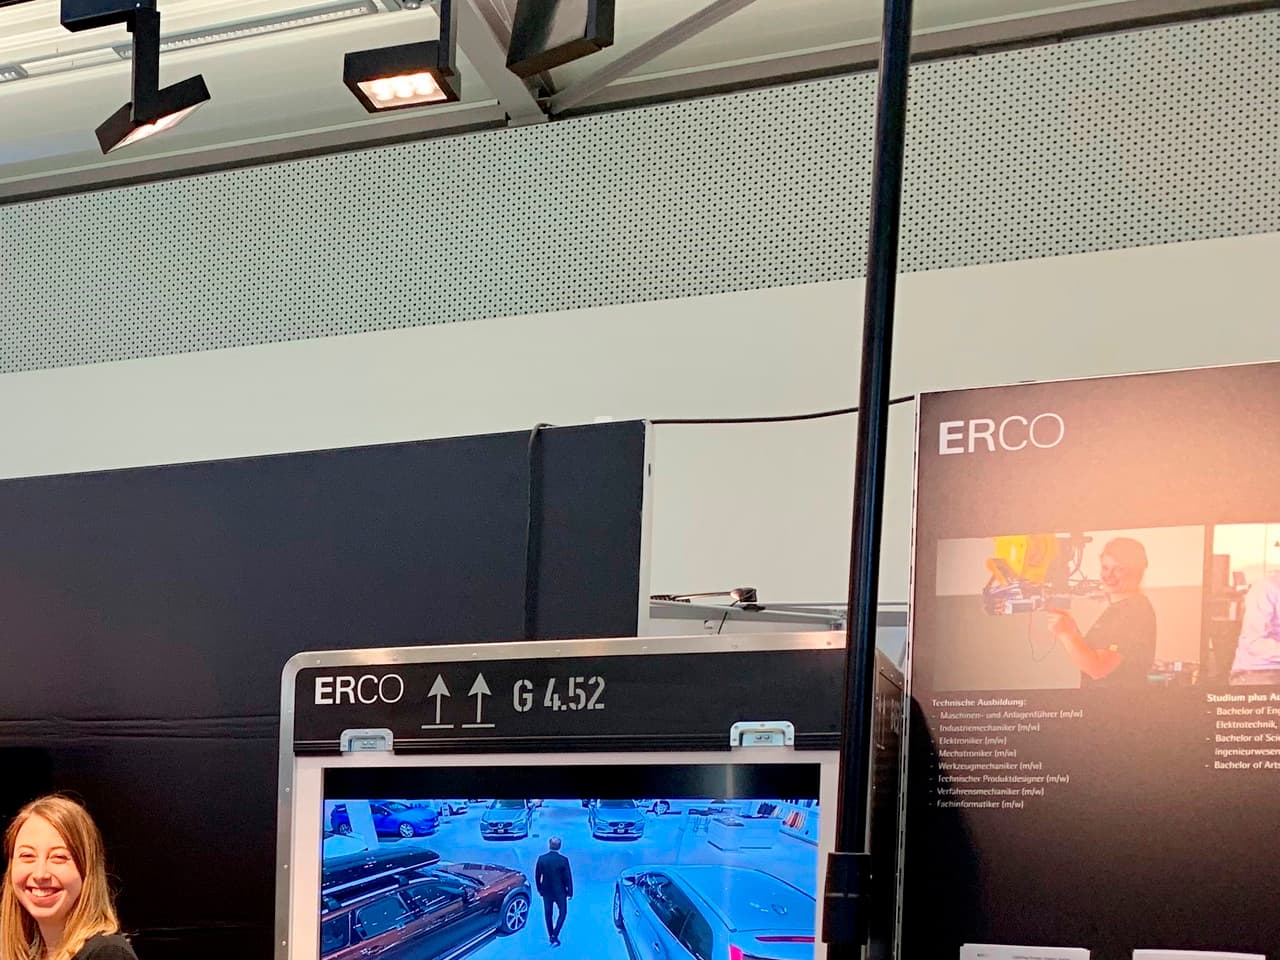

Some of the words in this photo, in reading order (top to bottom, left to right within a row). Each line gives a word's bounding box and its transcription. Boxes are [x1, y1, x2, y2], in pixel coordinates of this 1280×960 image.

[939, 412, 1065, 455] ERCO
[315, 674, 404, 705] ERCO
[513, 679, 533, 712] G
[544, 676, 606, 711] 4.52
[1207, 694, 1246, 702] Studium
[932, 699, 975, 707] Technische
[977, 699, 1026, 708] Ausbildung:
[986, 711, 1001, 719] und
[1216, 707, 1253, 715] Bachelor
[1255, 706, 1264, 715] of
[939, 724, 1016, 732] Industriemechaniker
[939, 737, 983, 745] Elektroniker
[1215, 734, 1251, 742] Bachelor
[1254, 733, 1263, 742] of
[939, 749, 992, 758] Mechatroniker
[938, 762, 1018, 771] Werkzeugmechaniker
[1214, 761, 1251, 769] Bachelor
[1253, 760, 1262, 769] of
[938, 774, 980, 783] Technischer
[983, 774, 1044, 784] Produktdesigner
[937, 787, 1019, 796] Verfahrensmechaniker
[937, 799, 1000, 808] Fachinformatiker
